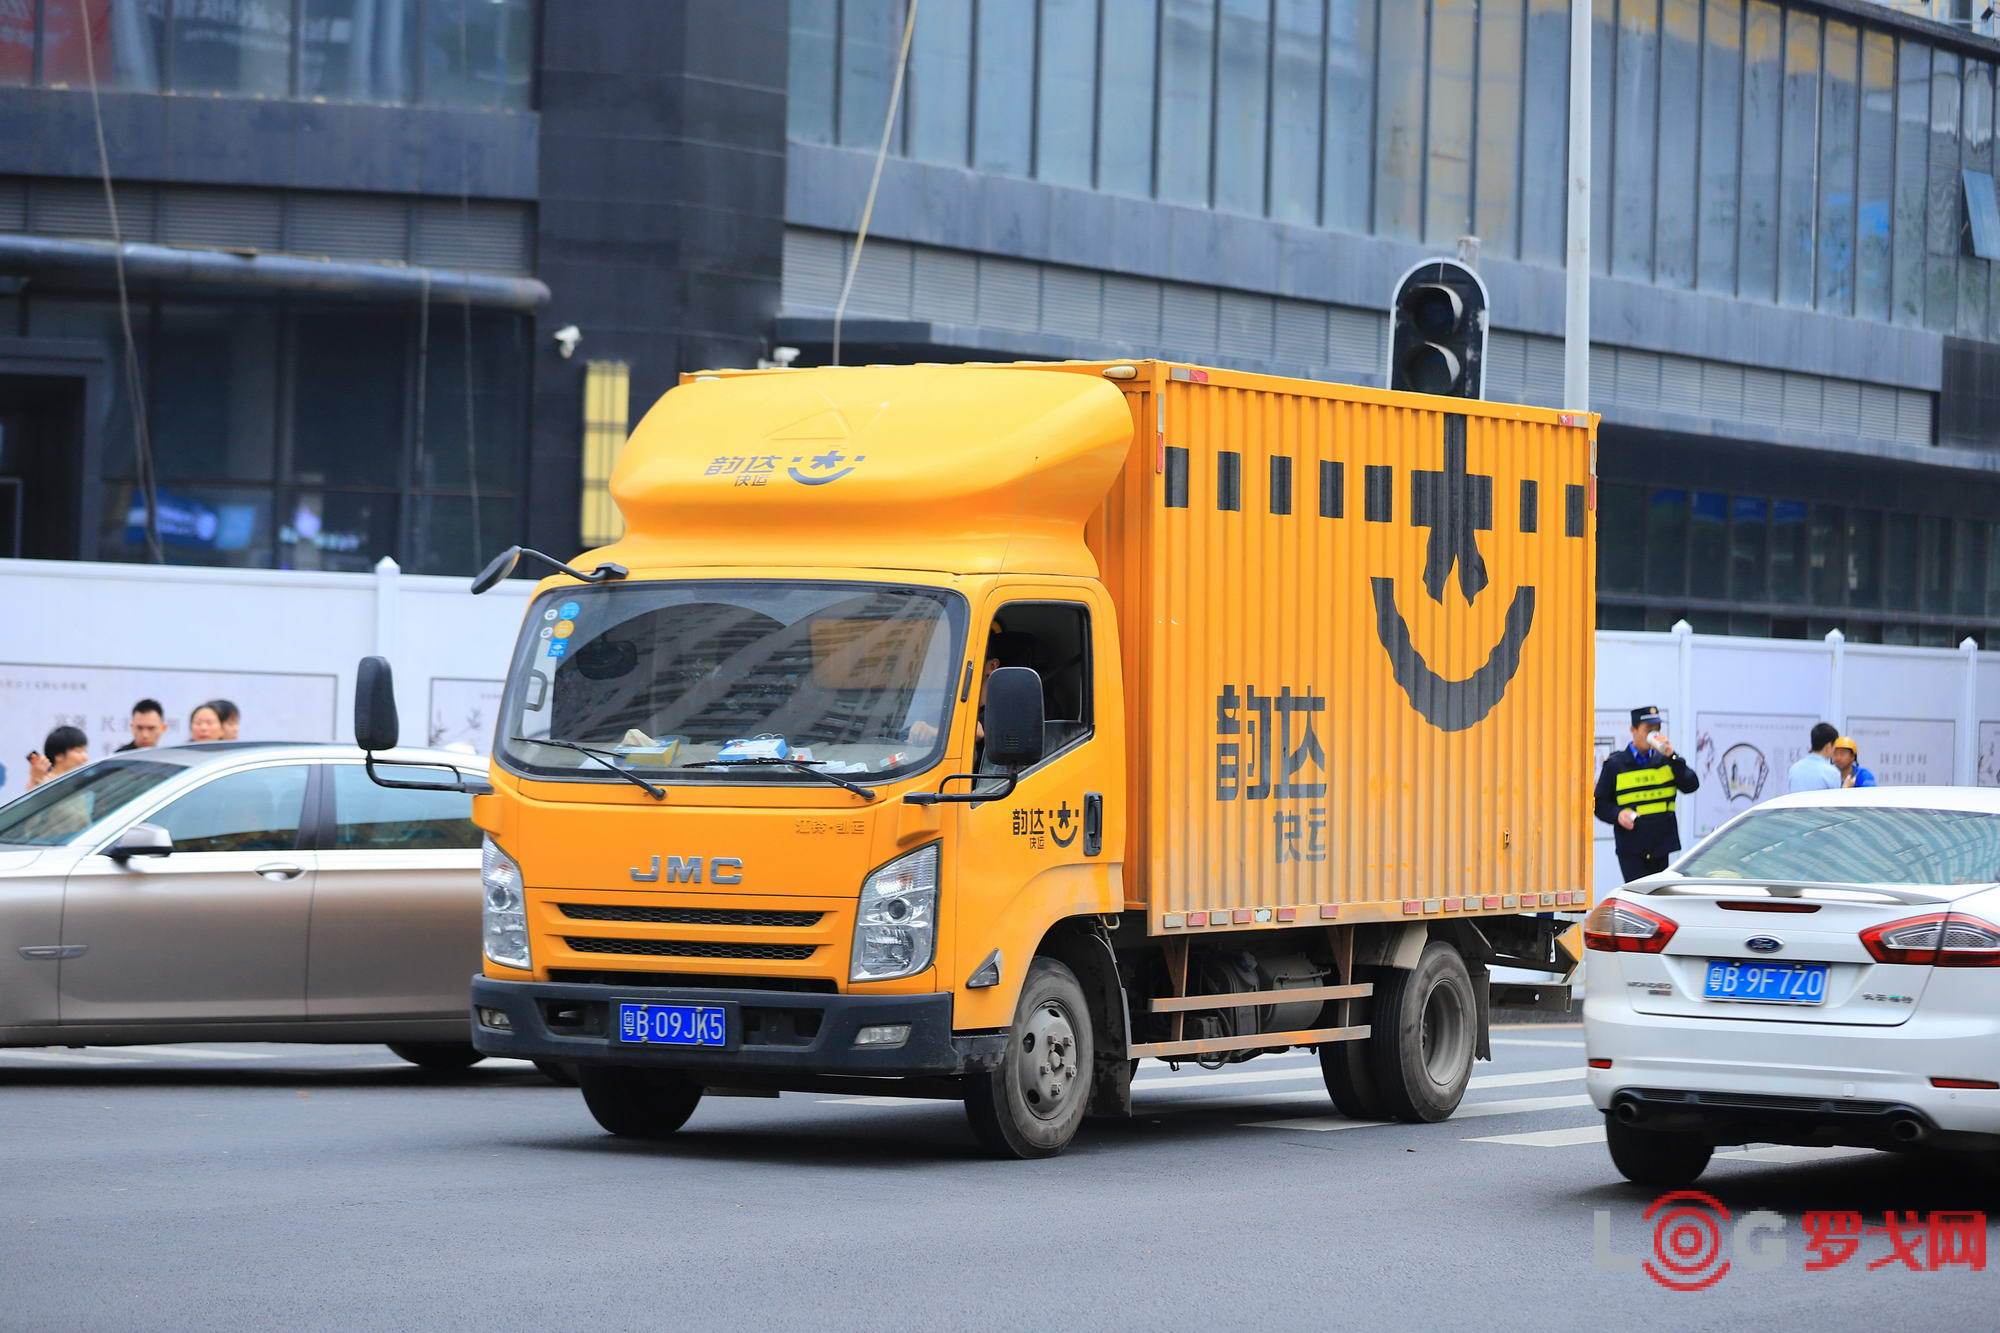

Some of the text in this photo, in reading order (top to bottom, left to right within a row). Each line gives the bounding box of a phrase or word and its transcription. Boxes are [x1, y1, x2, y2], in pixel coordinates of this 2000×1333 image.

[704, 456, 782, 475] 韵达
[733, 475, 768, 487] 快运
[1216, 685, 1327, 800] 韵达
[1013, 808, 1044, 835] 韵达
[1030, 836, 1044, 849] 快运
[1273, 808, 1326, 864] 快运
[630, 855, 743, 884] JMC
